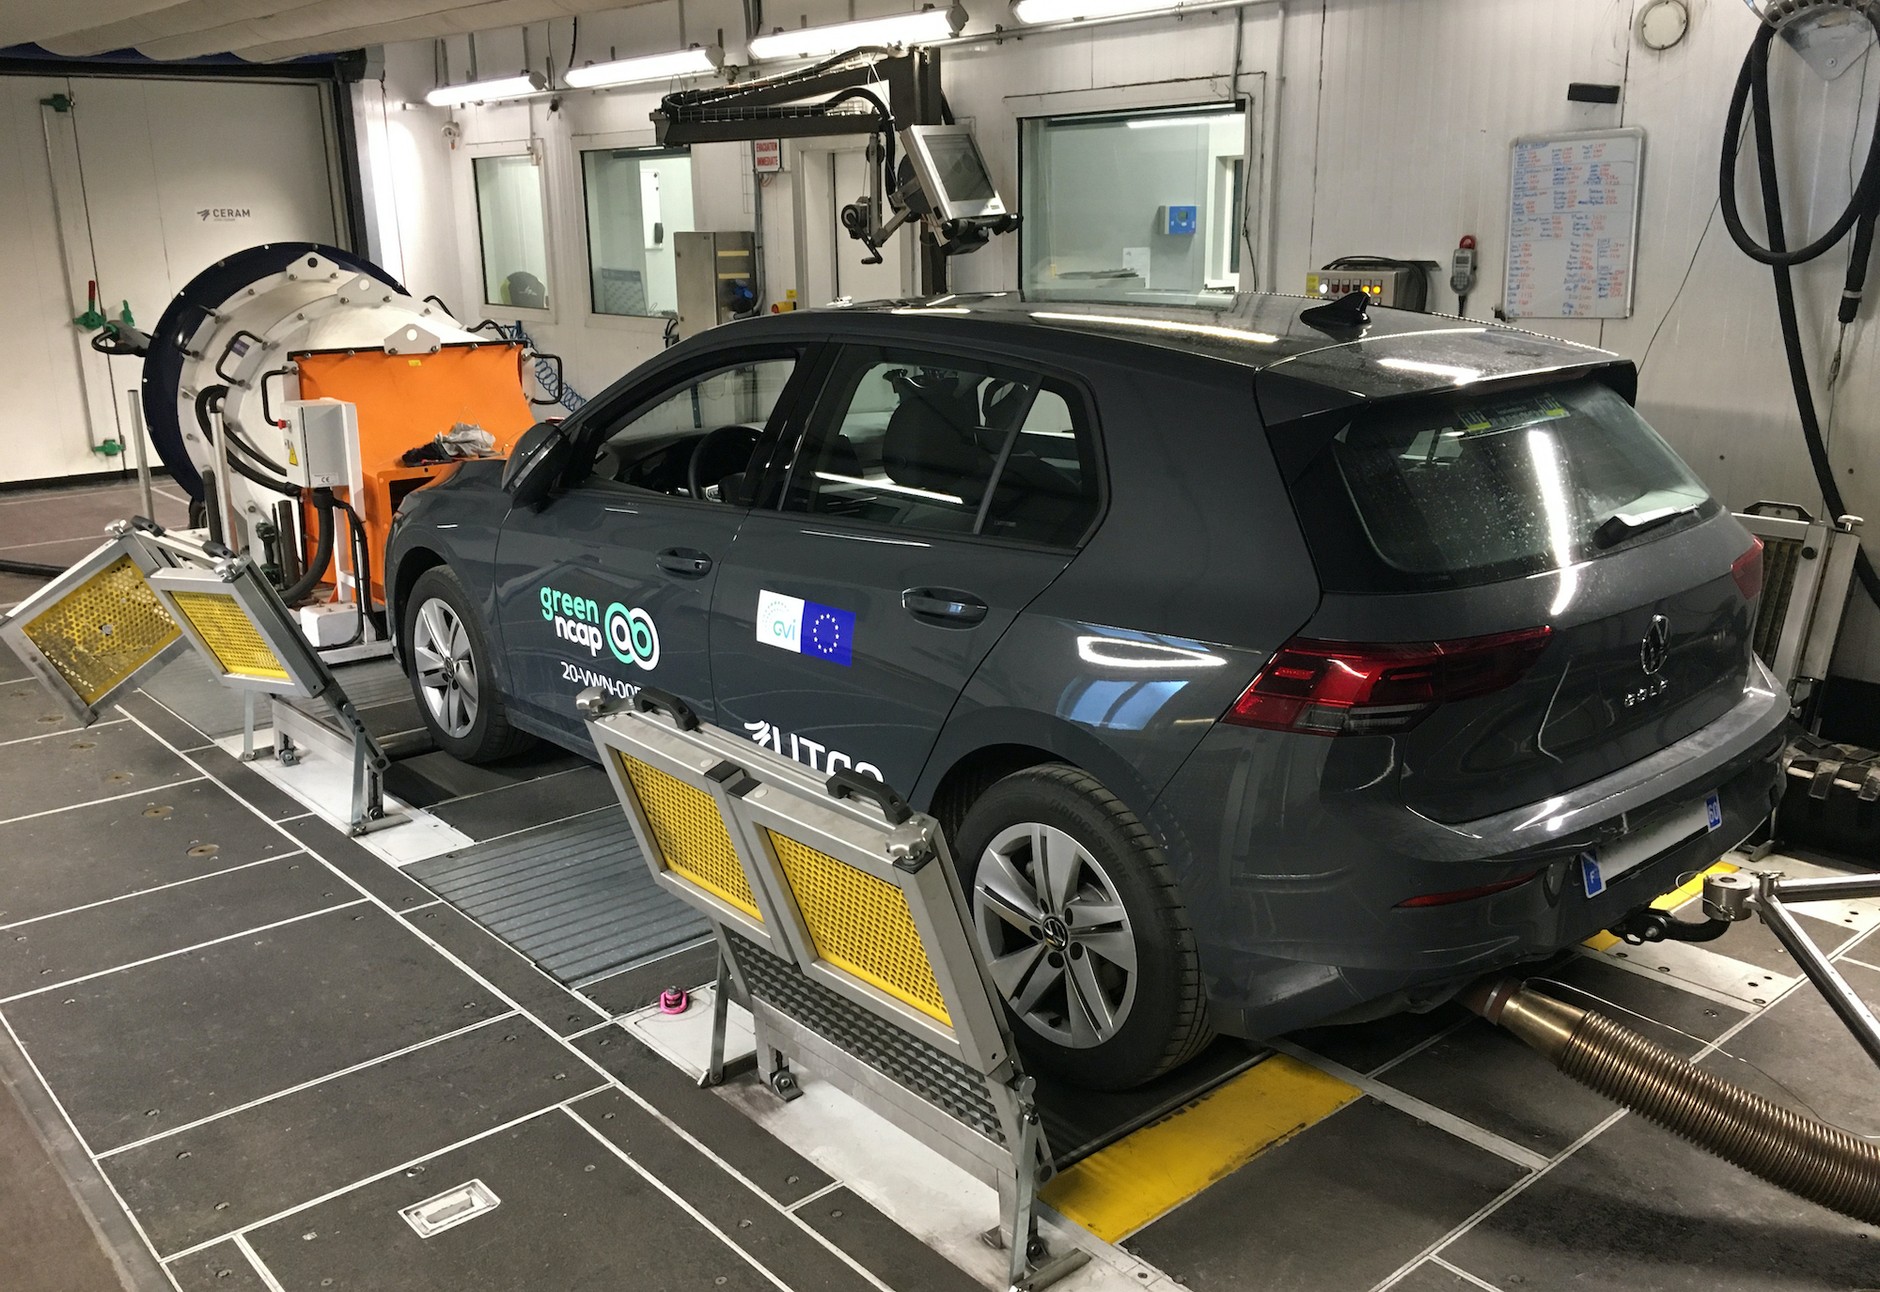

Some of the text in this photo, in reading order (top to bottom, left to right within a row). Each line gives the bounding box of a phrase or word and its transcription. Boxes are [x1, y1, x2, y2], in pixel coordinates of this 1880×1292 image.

[756, 156, 779, 166] IMMEDIATE
[212, 208, 251, 218] CERAM
[540, 586, 599, 624] green
[555, 615, 603, 657] ncap
[1624, 679, 1669, 708] GOLF
[1708, 801, 1720, 823] 60
[1590, 869, 1598, 884] F
